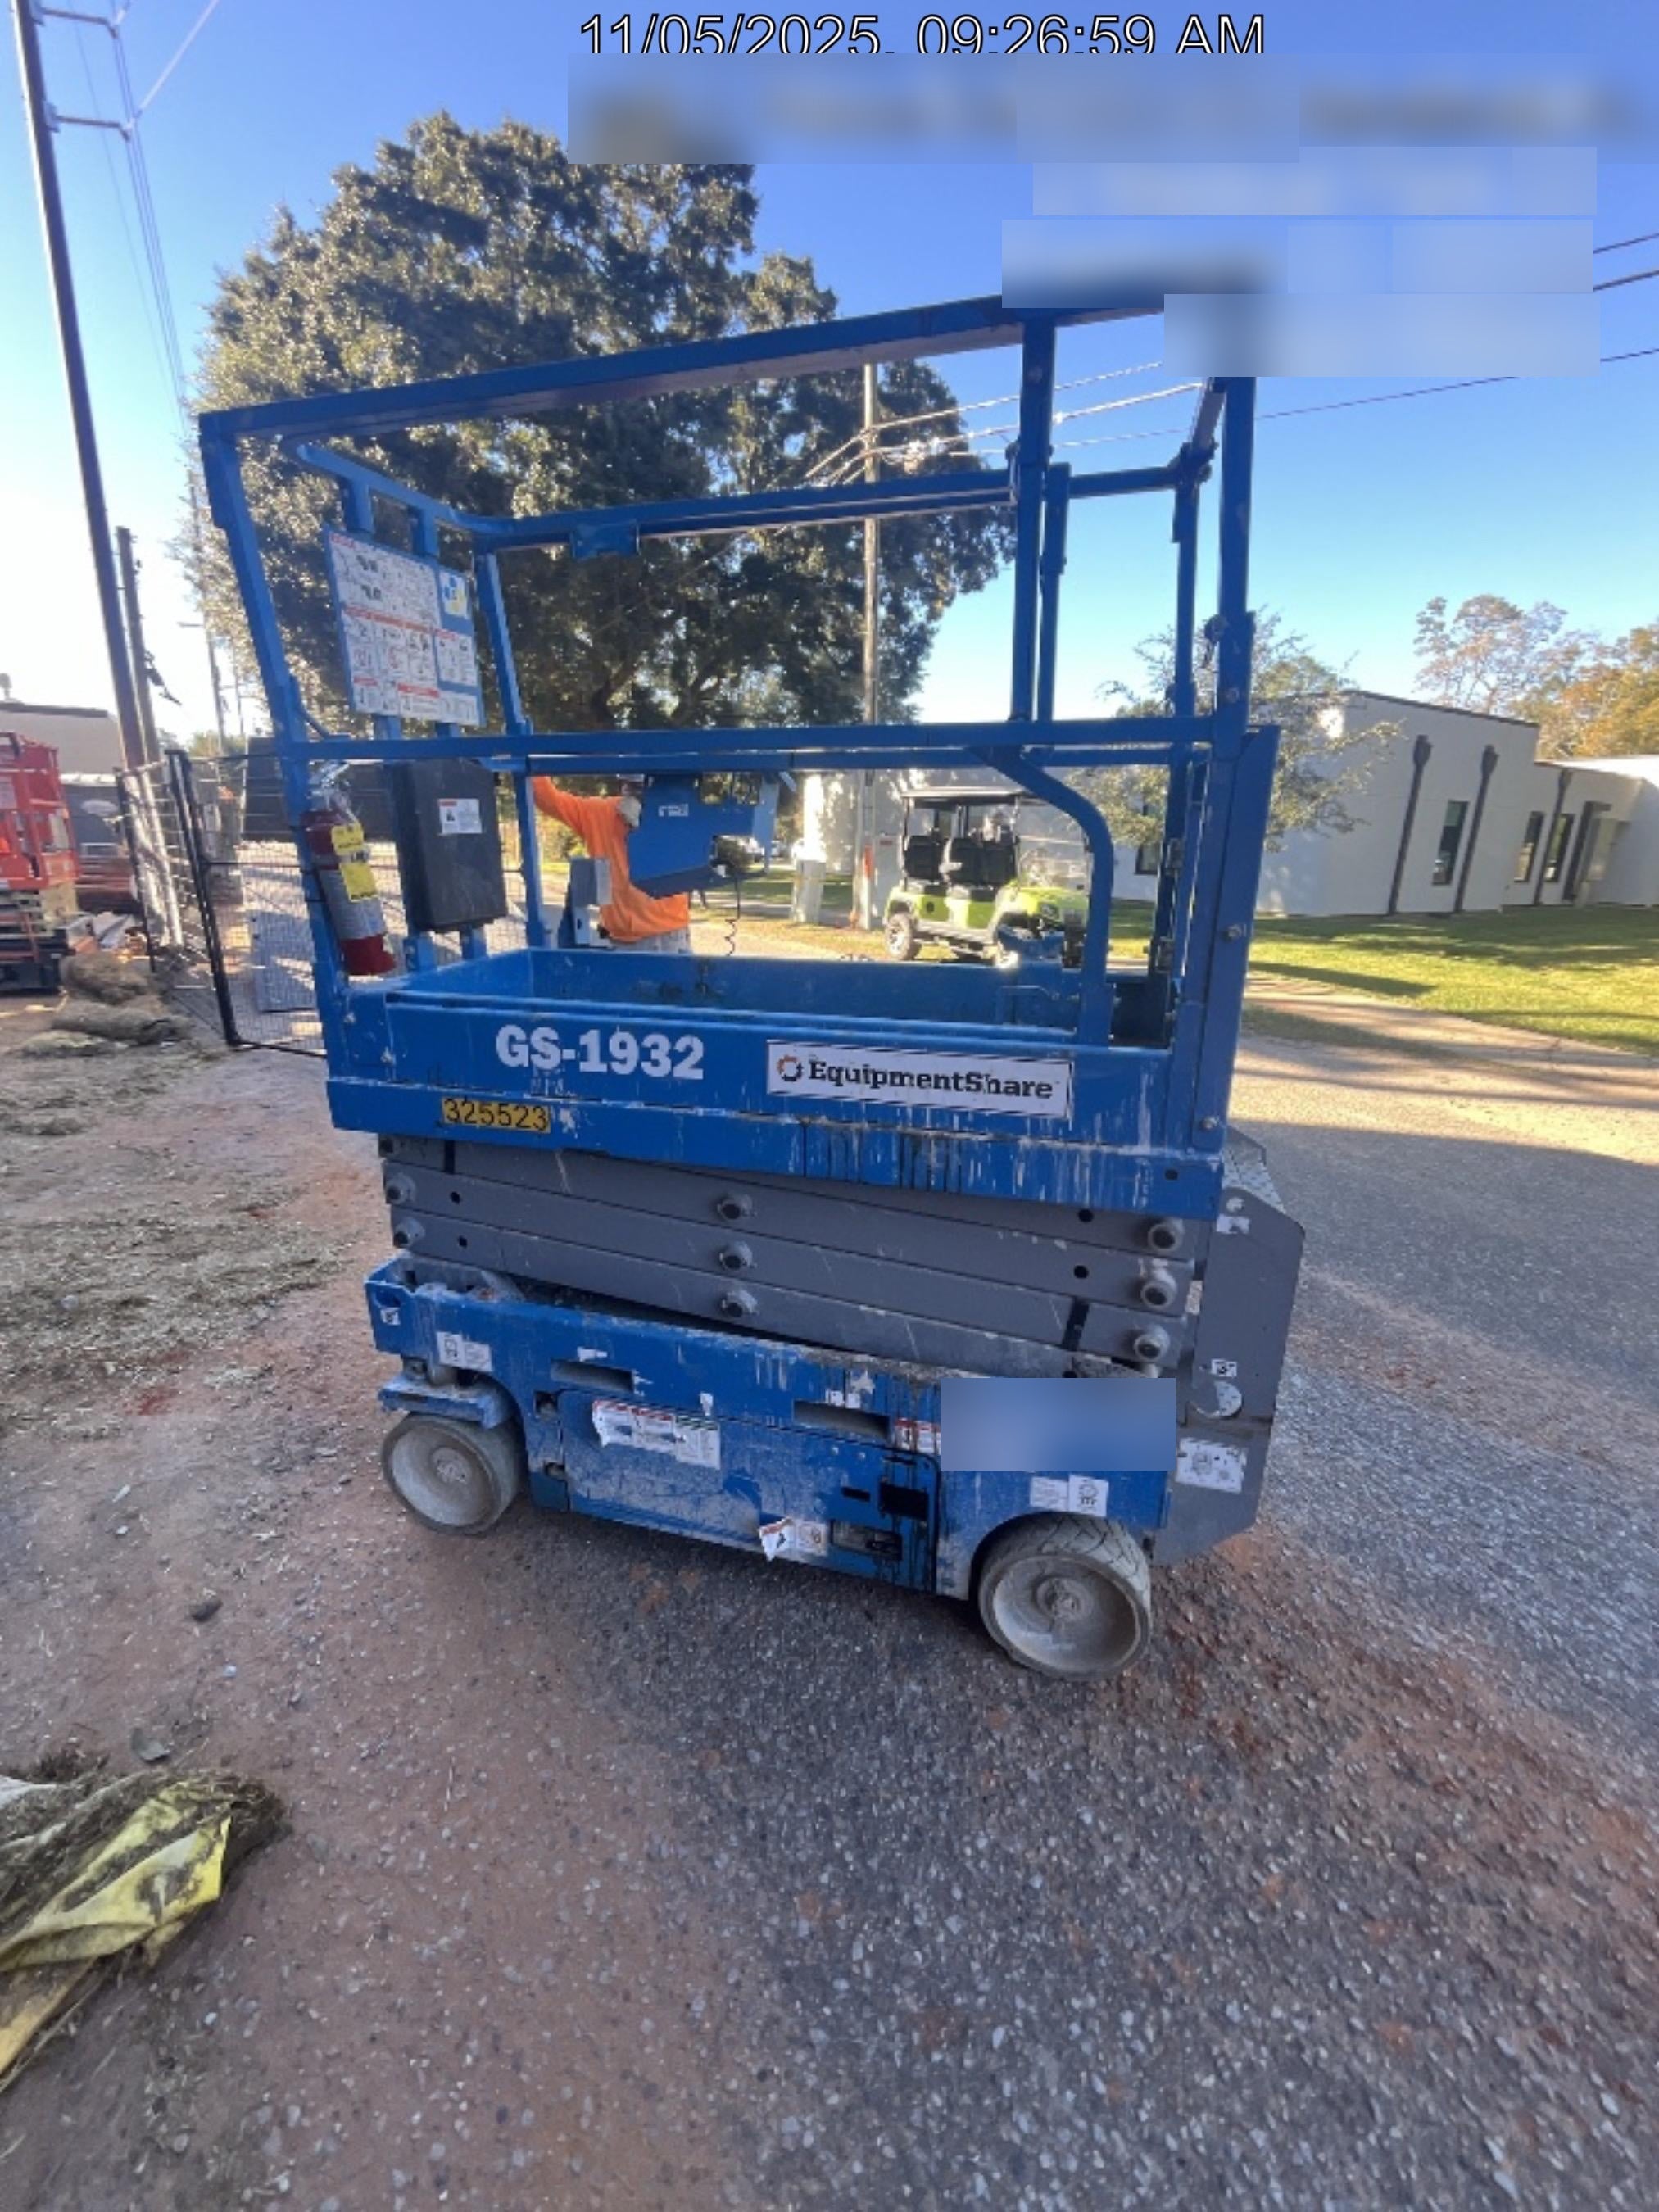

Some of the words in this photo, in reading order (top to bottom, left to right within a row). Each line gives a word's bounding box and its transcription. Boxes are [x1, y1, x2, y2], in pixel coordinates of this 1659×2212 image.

[496, 1024, 705, 1080] GS-1932
[808, 1060, 1054, 1099] EquipmentShare
[443, 1098, 549, 1131] 325523
